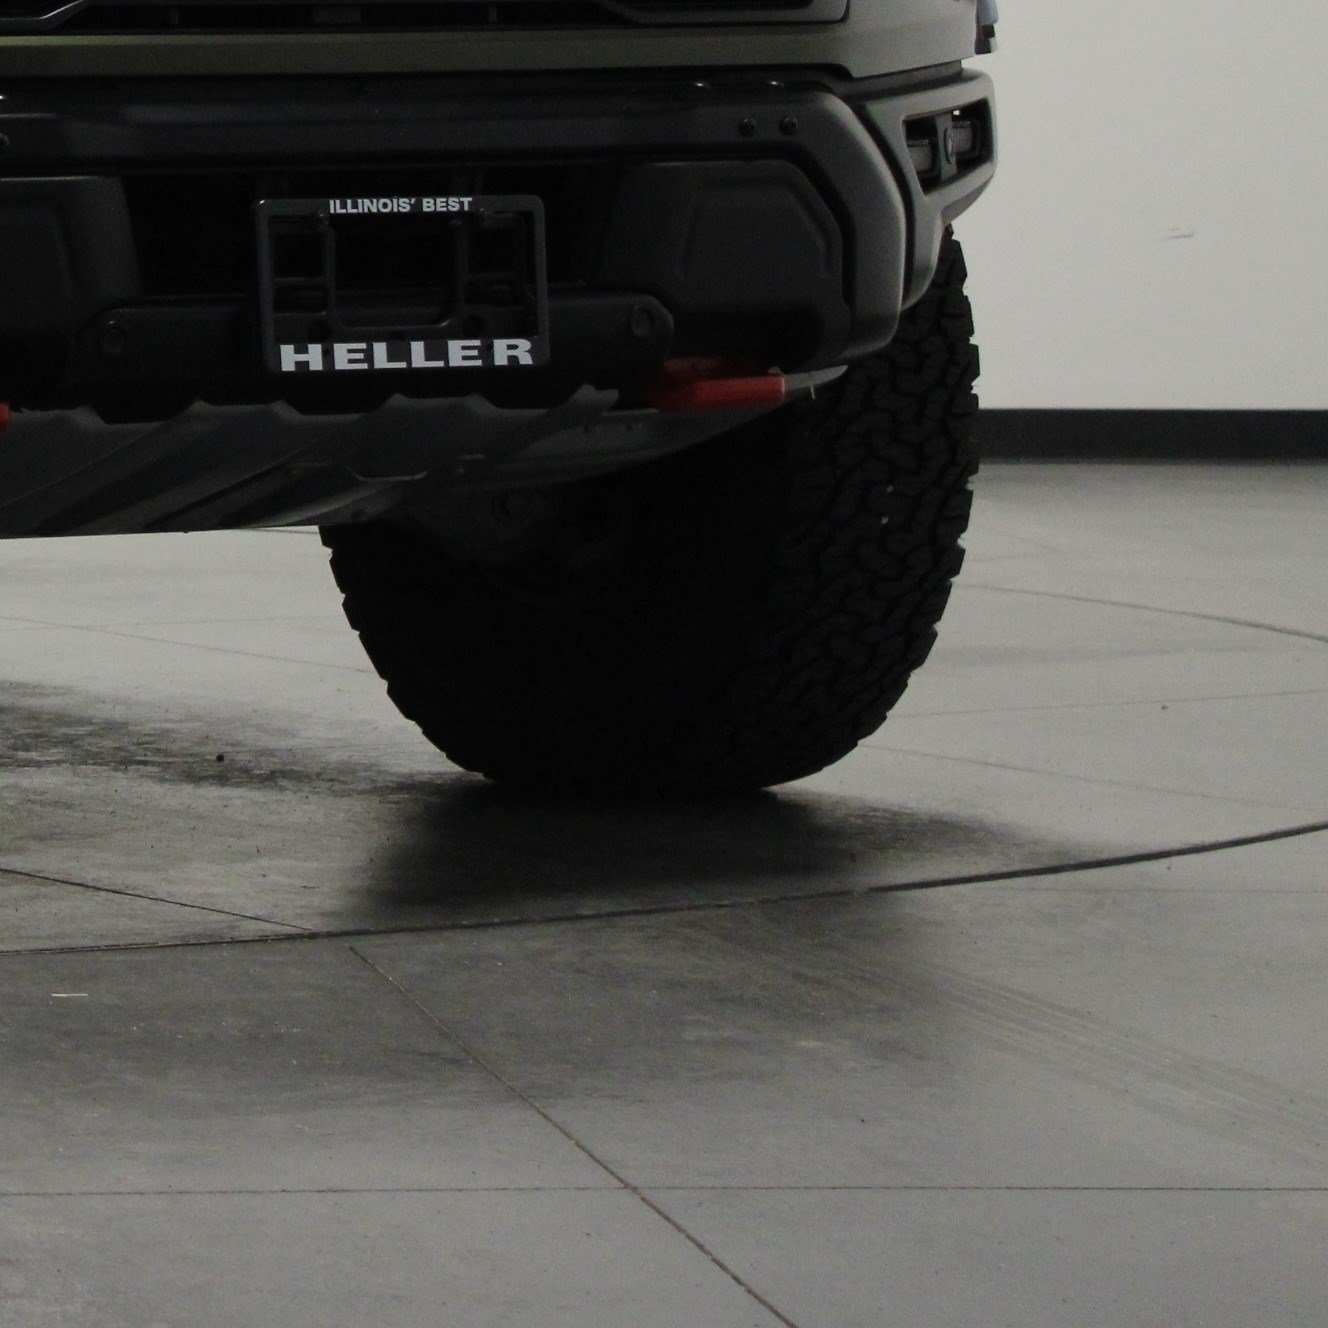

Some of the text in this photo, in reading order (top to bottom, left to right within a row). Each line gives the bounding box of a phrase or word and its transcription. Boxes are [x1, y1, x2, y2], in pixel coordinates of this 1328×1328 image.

[329, 197, 472, 213] ILLINOIS' BEST
[280, 338, 533, 371] HELLER
